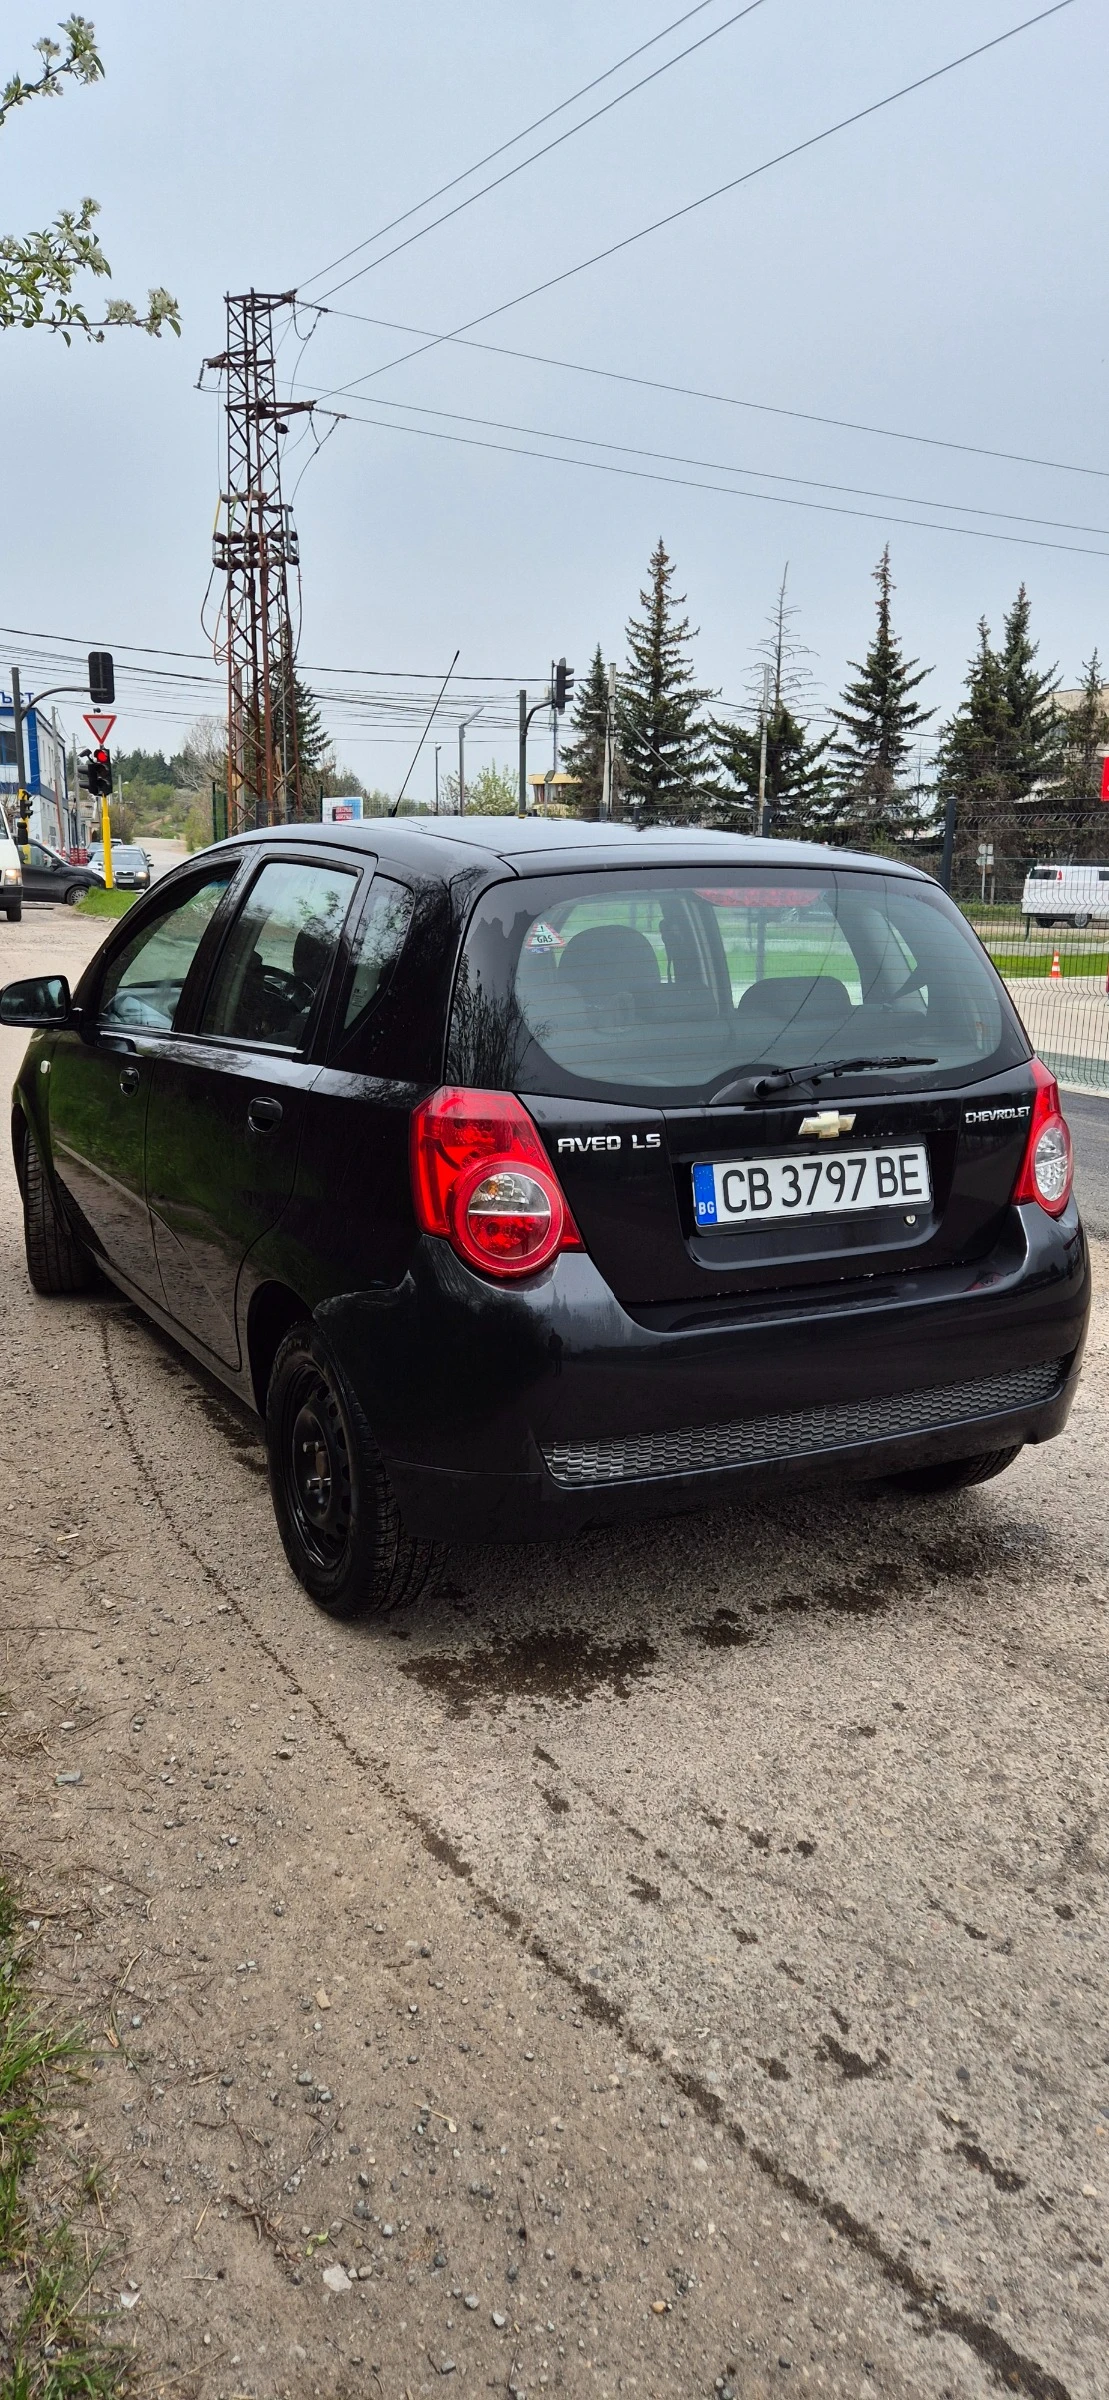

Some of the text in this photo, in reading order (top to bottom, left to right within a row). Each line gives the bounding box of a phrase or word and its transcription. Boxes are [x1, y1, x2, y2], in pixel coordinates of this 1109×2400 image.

[537, 934, 553, 943] GAS
[965, 1105, 1031, 1124] CHEVROLET
[557, 1133, 661, 1153] AVEO LS
[722, 1154, 922, 1213] CB 3797 BE
[698, 1201, 715, 1215] BG
